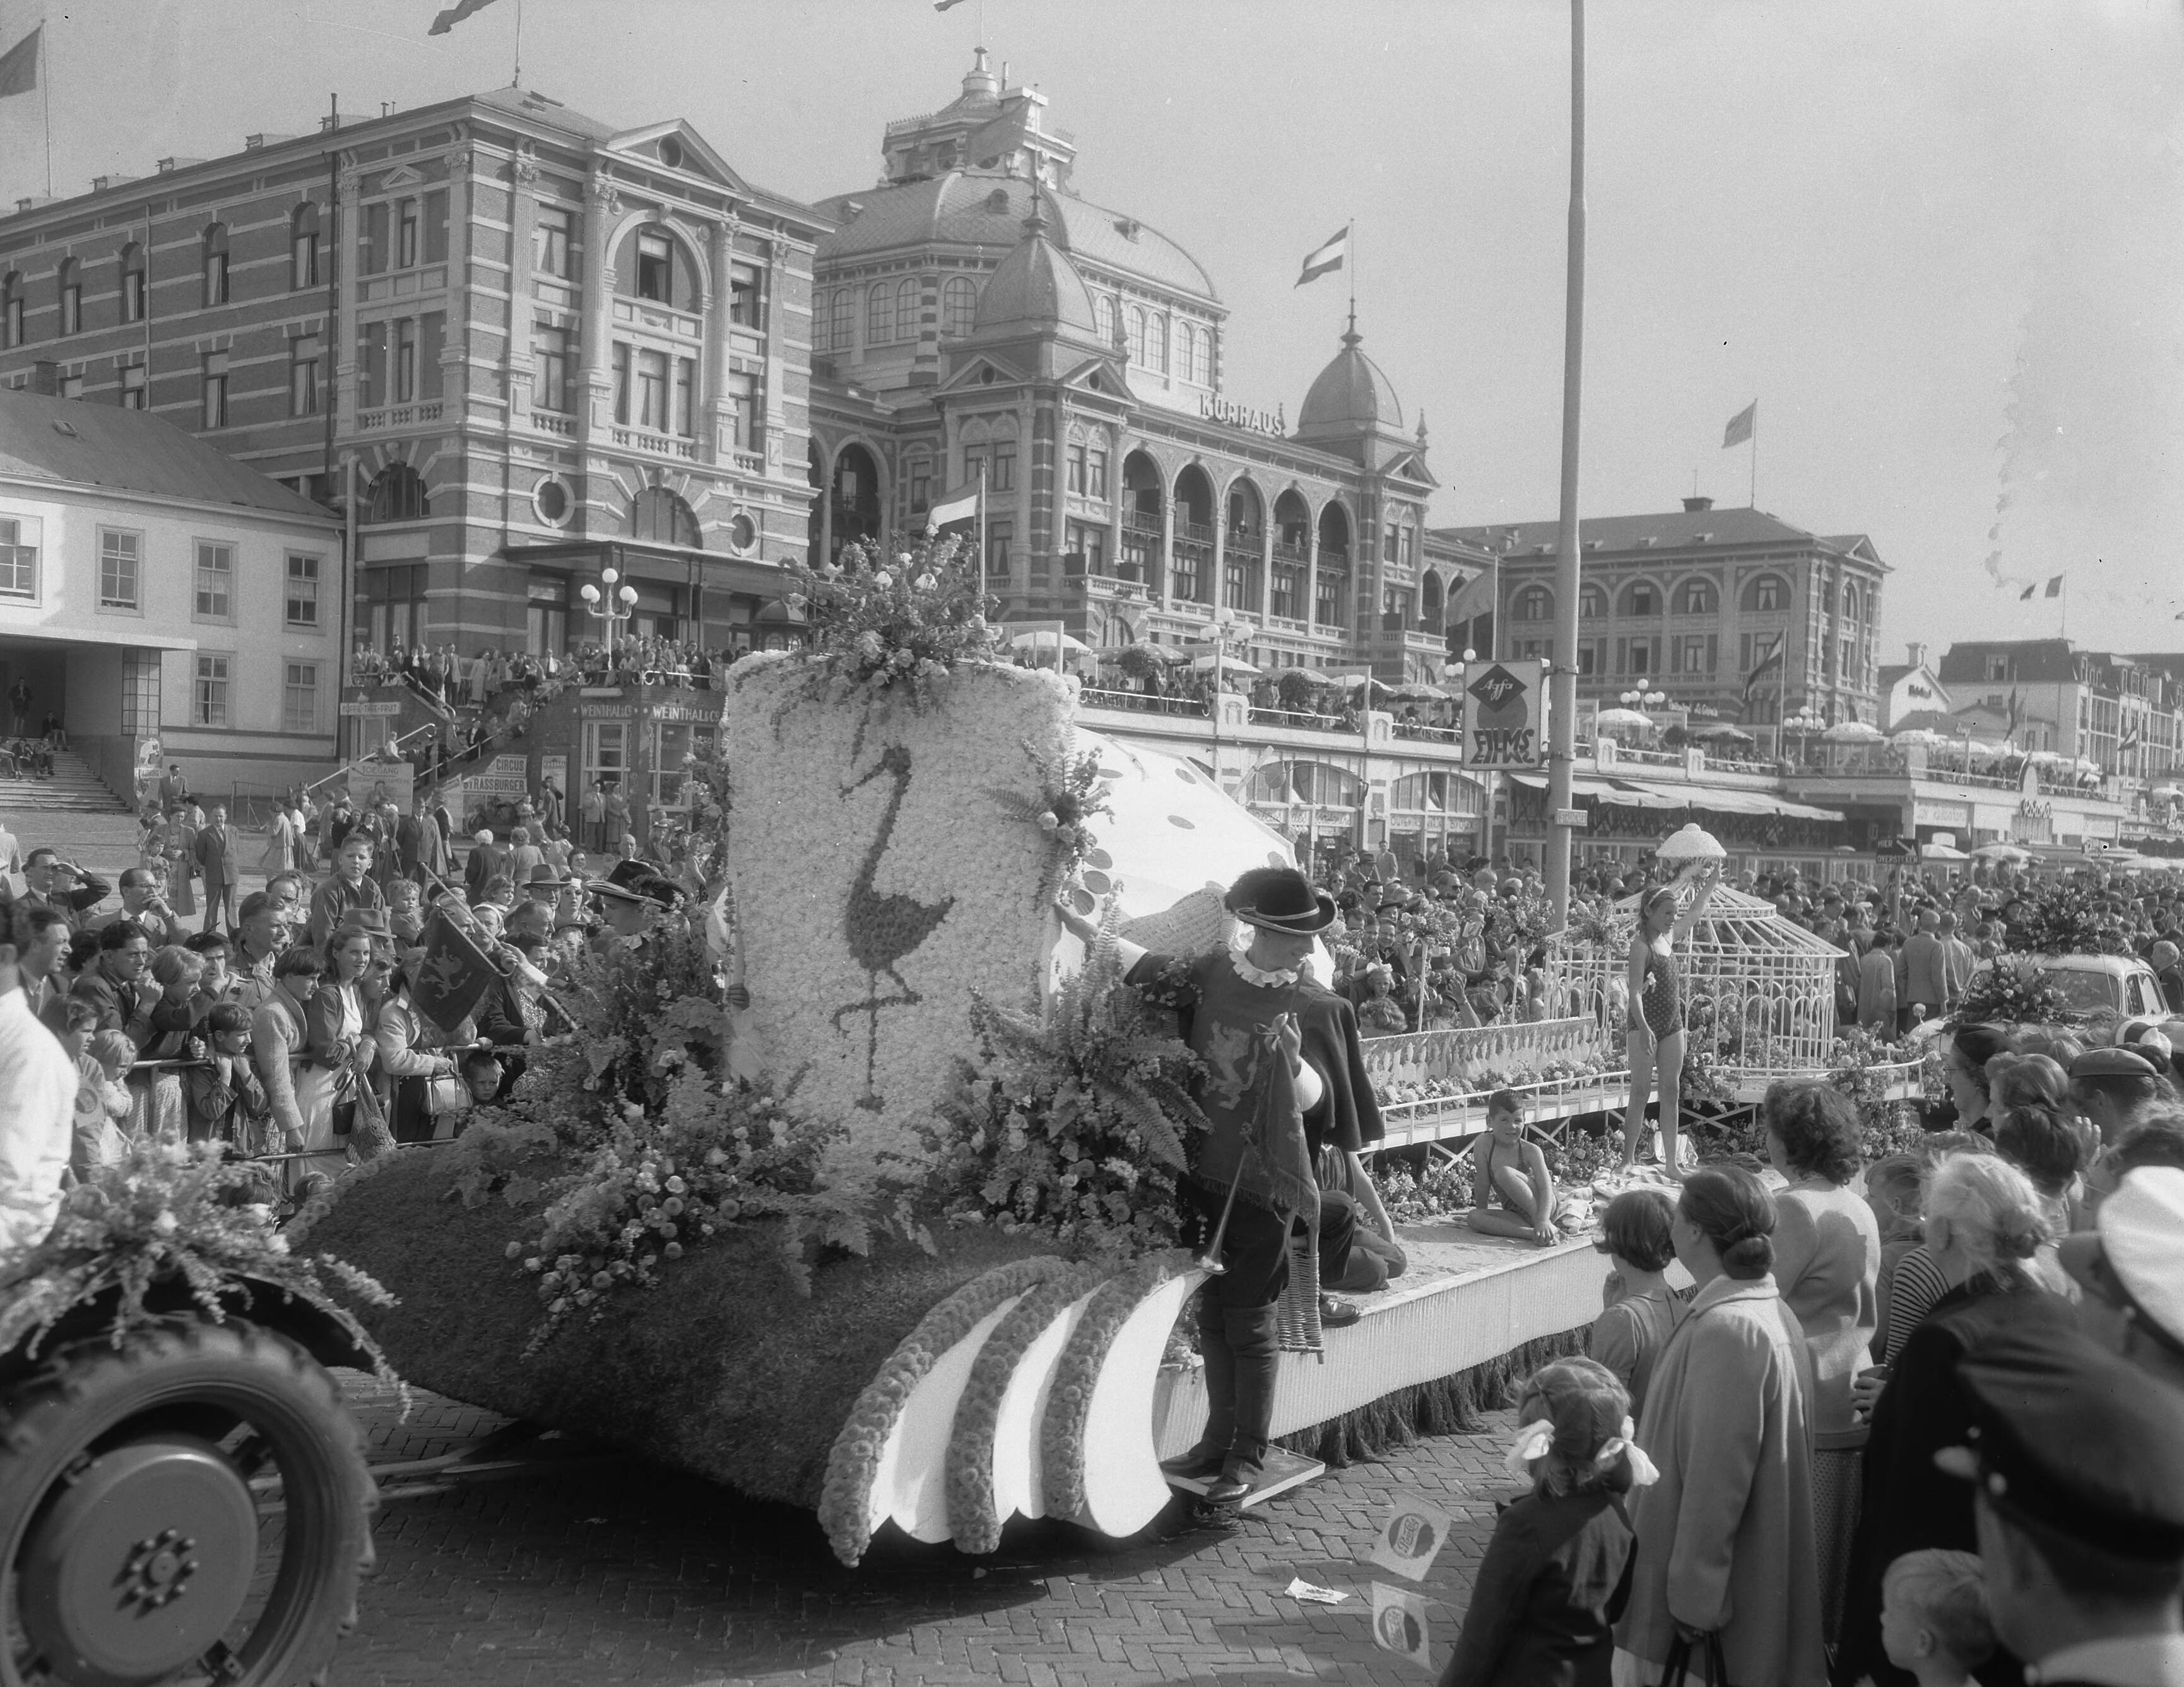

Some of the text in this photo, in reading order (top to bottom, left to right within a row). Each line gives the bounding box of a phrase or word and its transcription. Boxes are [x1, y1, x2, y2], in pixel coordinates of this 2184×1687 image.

[1200, 394, 1282, 435] KURHAUS
[1479, 678, 1514, 701] Agfa
[581, 703, 621, 717] WEINTHAL
[652, 705, 705, 721] WEINTHAL
[1472, 728, 1535, 753] FILMS
[362, 766, 399, 775] TOEGANG
[496, 758, 524, 772] CIRCUS
[463, 778, 524, 791] STRASSBURGER
[1877, 840, 1893, 849] HIER
[1877, 854, 1918, 864] OVERSTEKEN
